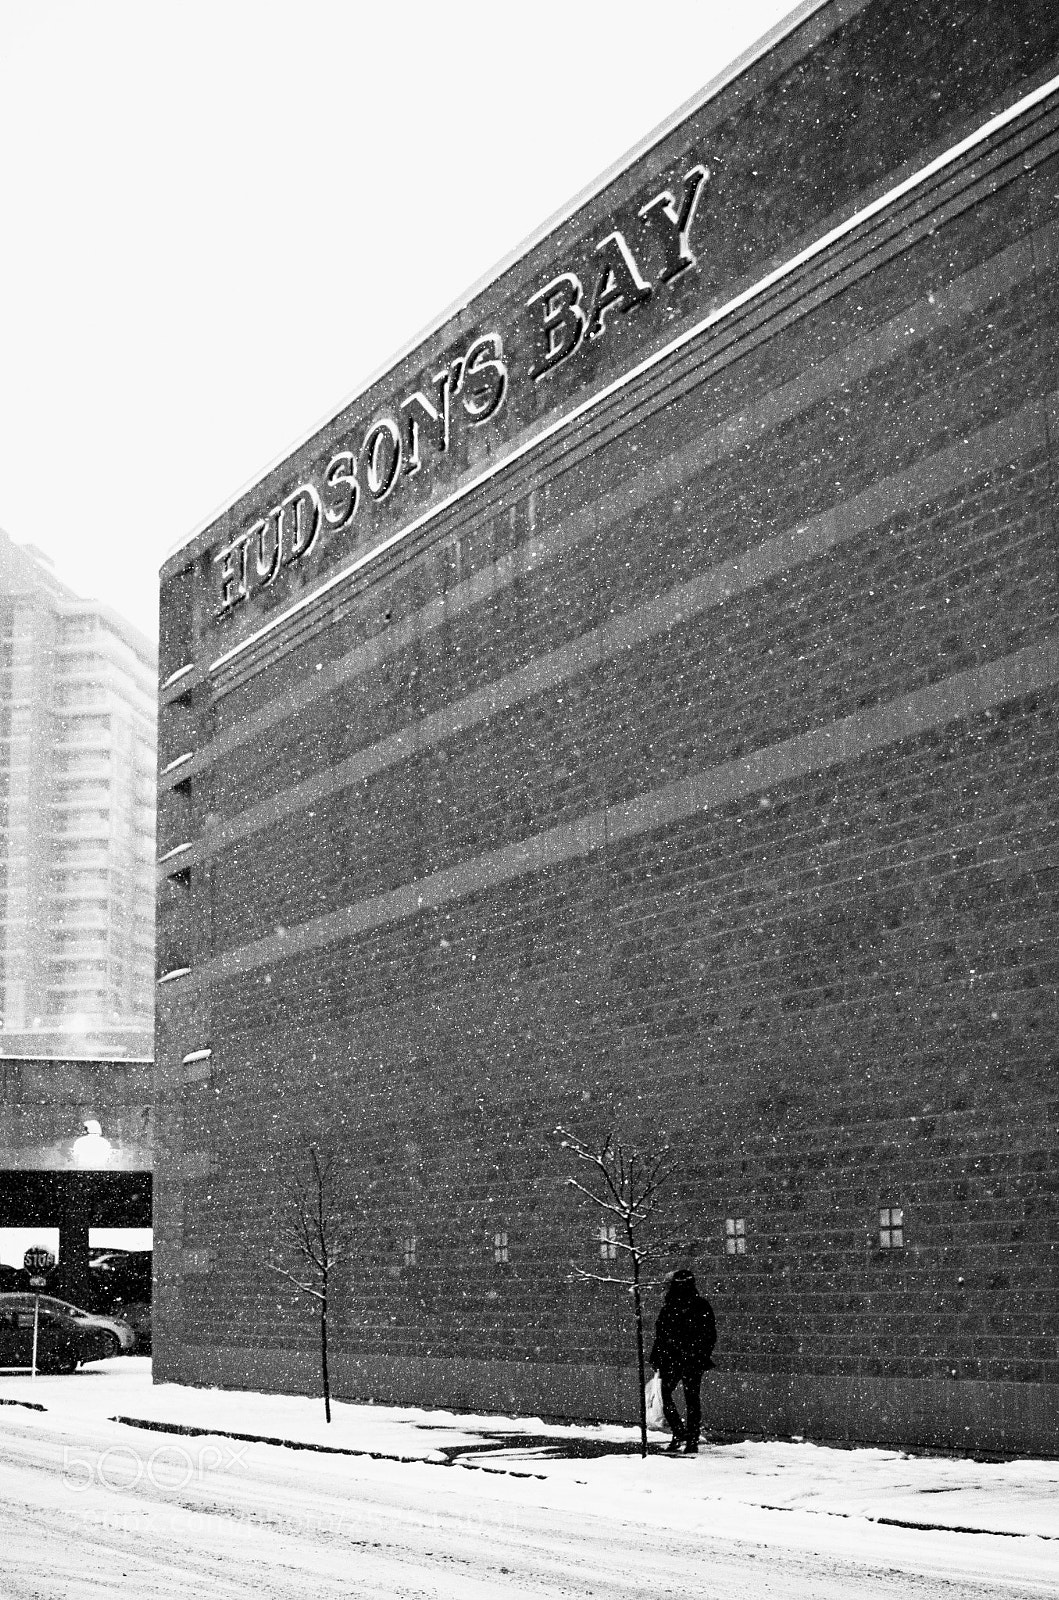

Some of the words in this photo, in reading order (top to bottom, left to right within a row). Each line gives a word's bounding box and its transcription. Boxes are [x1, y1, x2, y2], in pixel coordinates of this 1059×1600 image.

[214, 332, 508, 619] HUDSON'S
[525, 164, 710, 383] BAY
[24, 1253, 56, 1268] STOP
